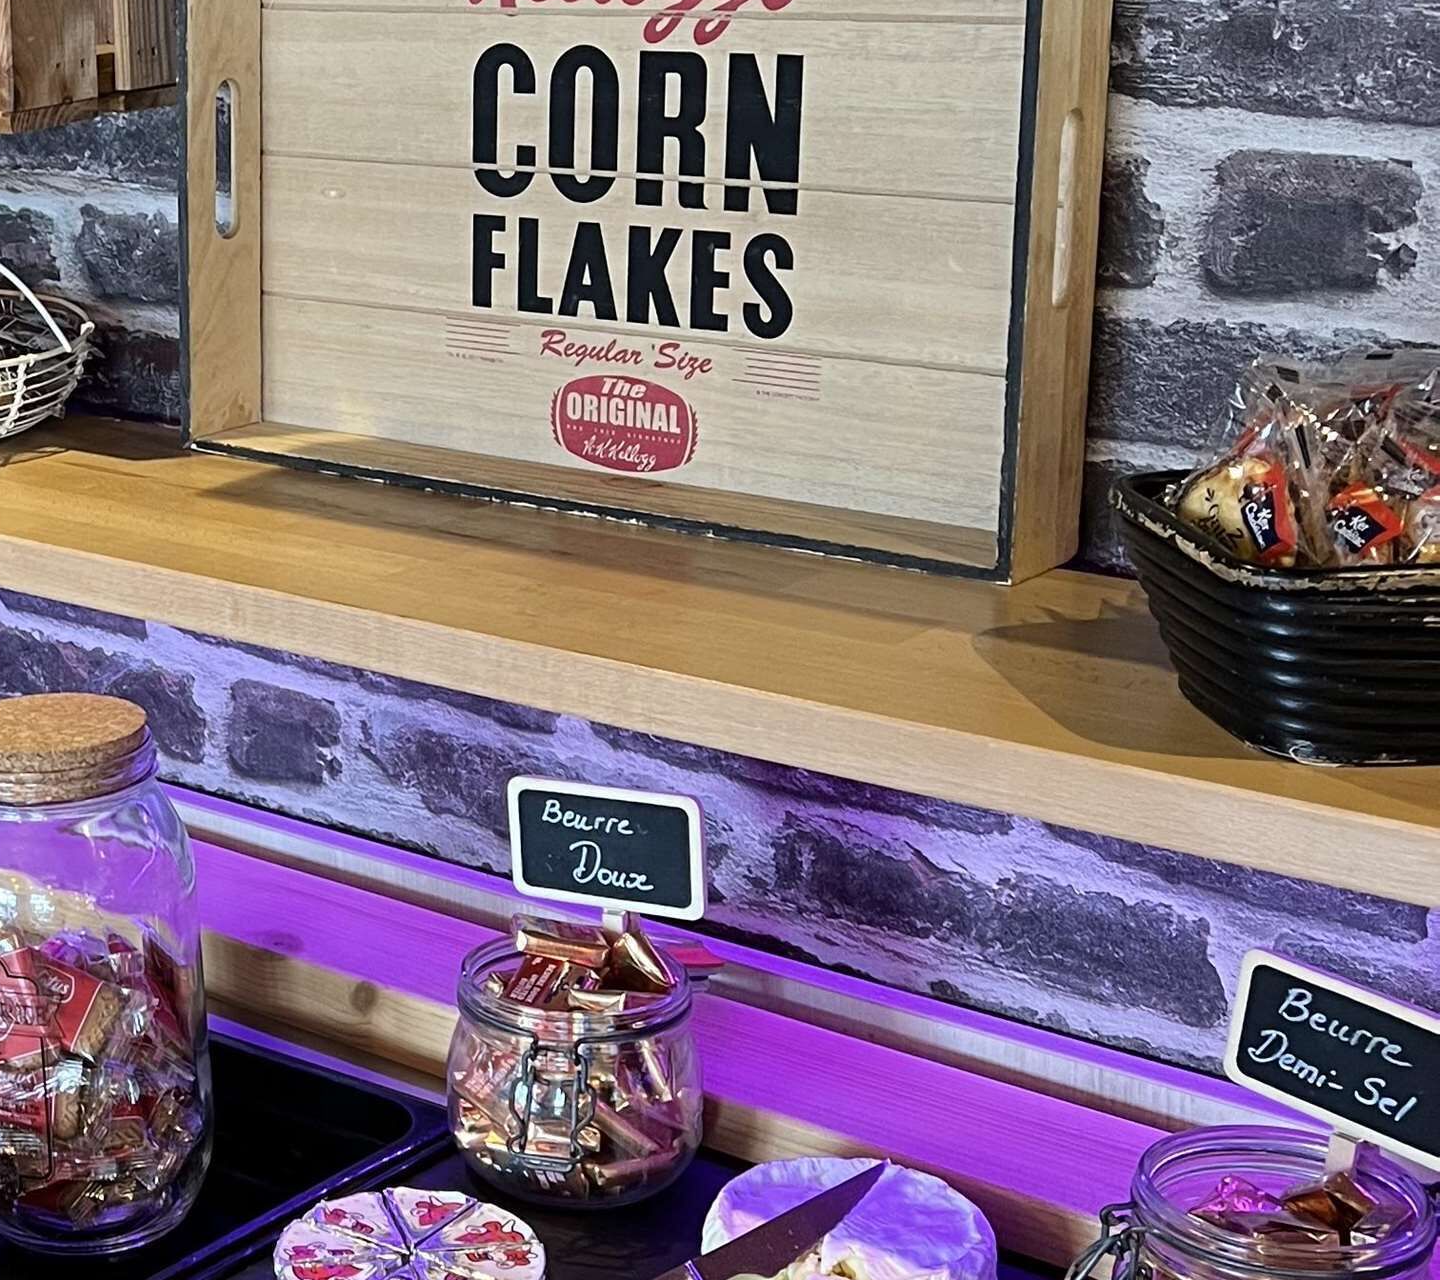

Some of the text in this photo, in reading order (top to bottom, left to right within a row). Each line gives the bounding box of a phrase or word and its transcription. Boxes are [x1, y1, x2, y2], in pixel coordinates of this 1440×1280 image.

[472, 42, 805, 216] CORN
[472, 214, 794, 339] FLAKES
[540, 329, 713, 380] Regular Size
[567, 392, 681, 434] ORIGINAL
[601, 377, 647, 398] The
[541, 799, 634, 835] Beurre
[569, 840, 654, 891] Doux
[1278, 988, 1413, 1067] Beurre
